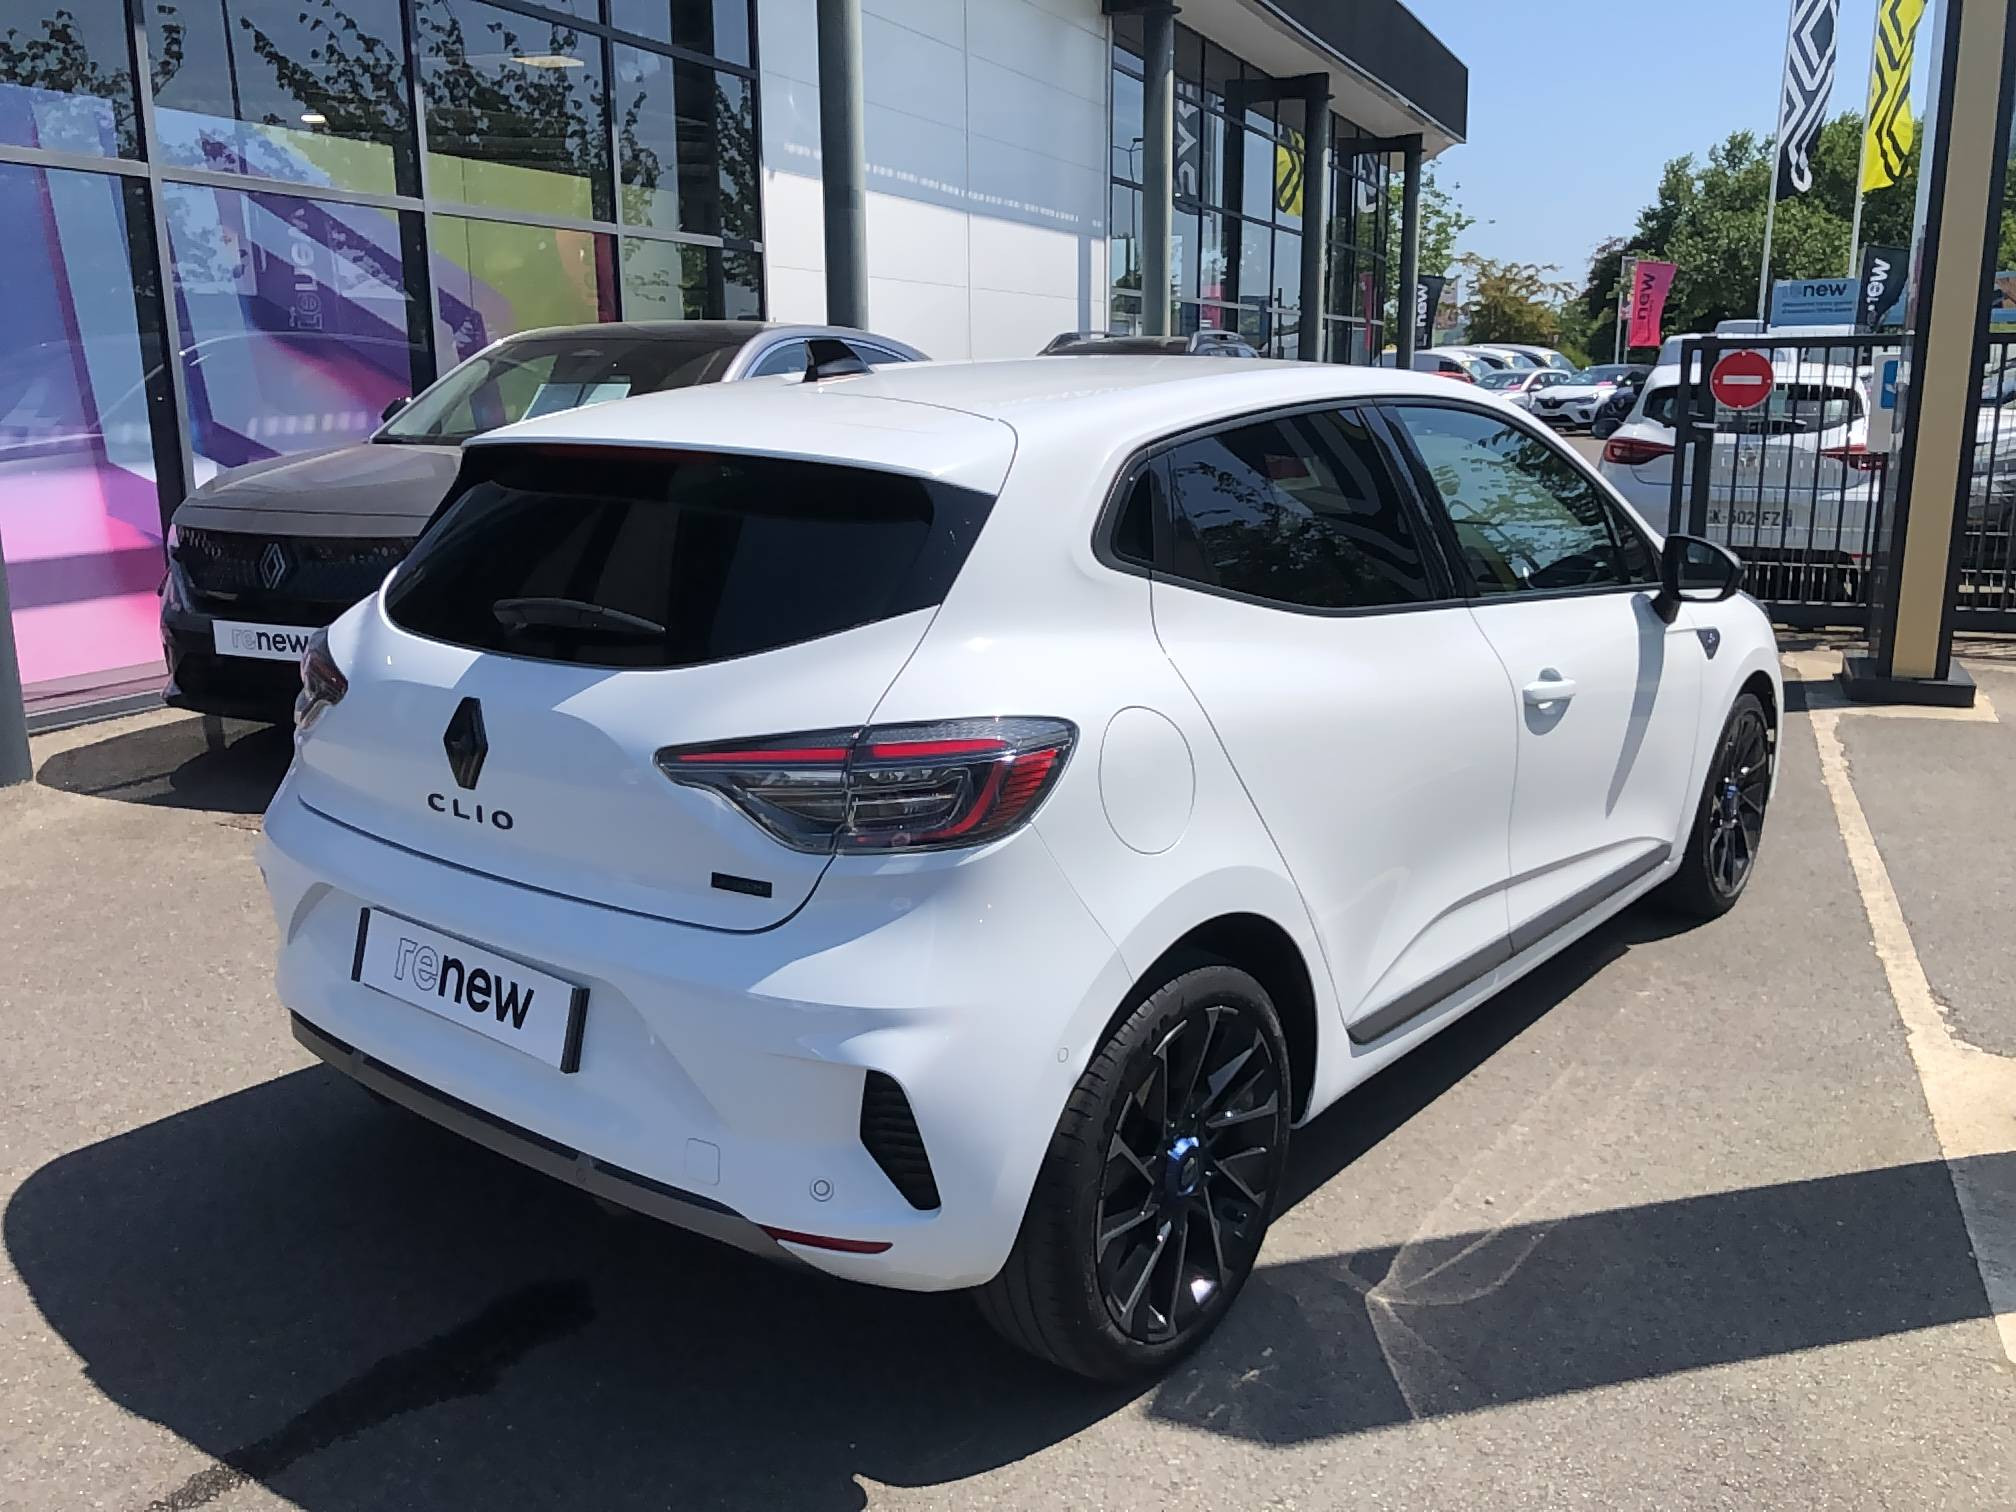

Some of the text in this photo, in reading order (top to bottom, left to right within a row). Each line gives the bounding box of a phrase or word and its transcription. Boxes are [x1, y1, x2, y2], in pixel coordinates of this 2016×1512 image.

[231, 628, 309, 654] renew
[427, 793, 514, 830] CLIO
[394, 936, 535, 1031] renew
